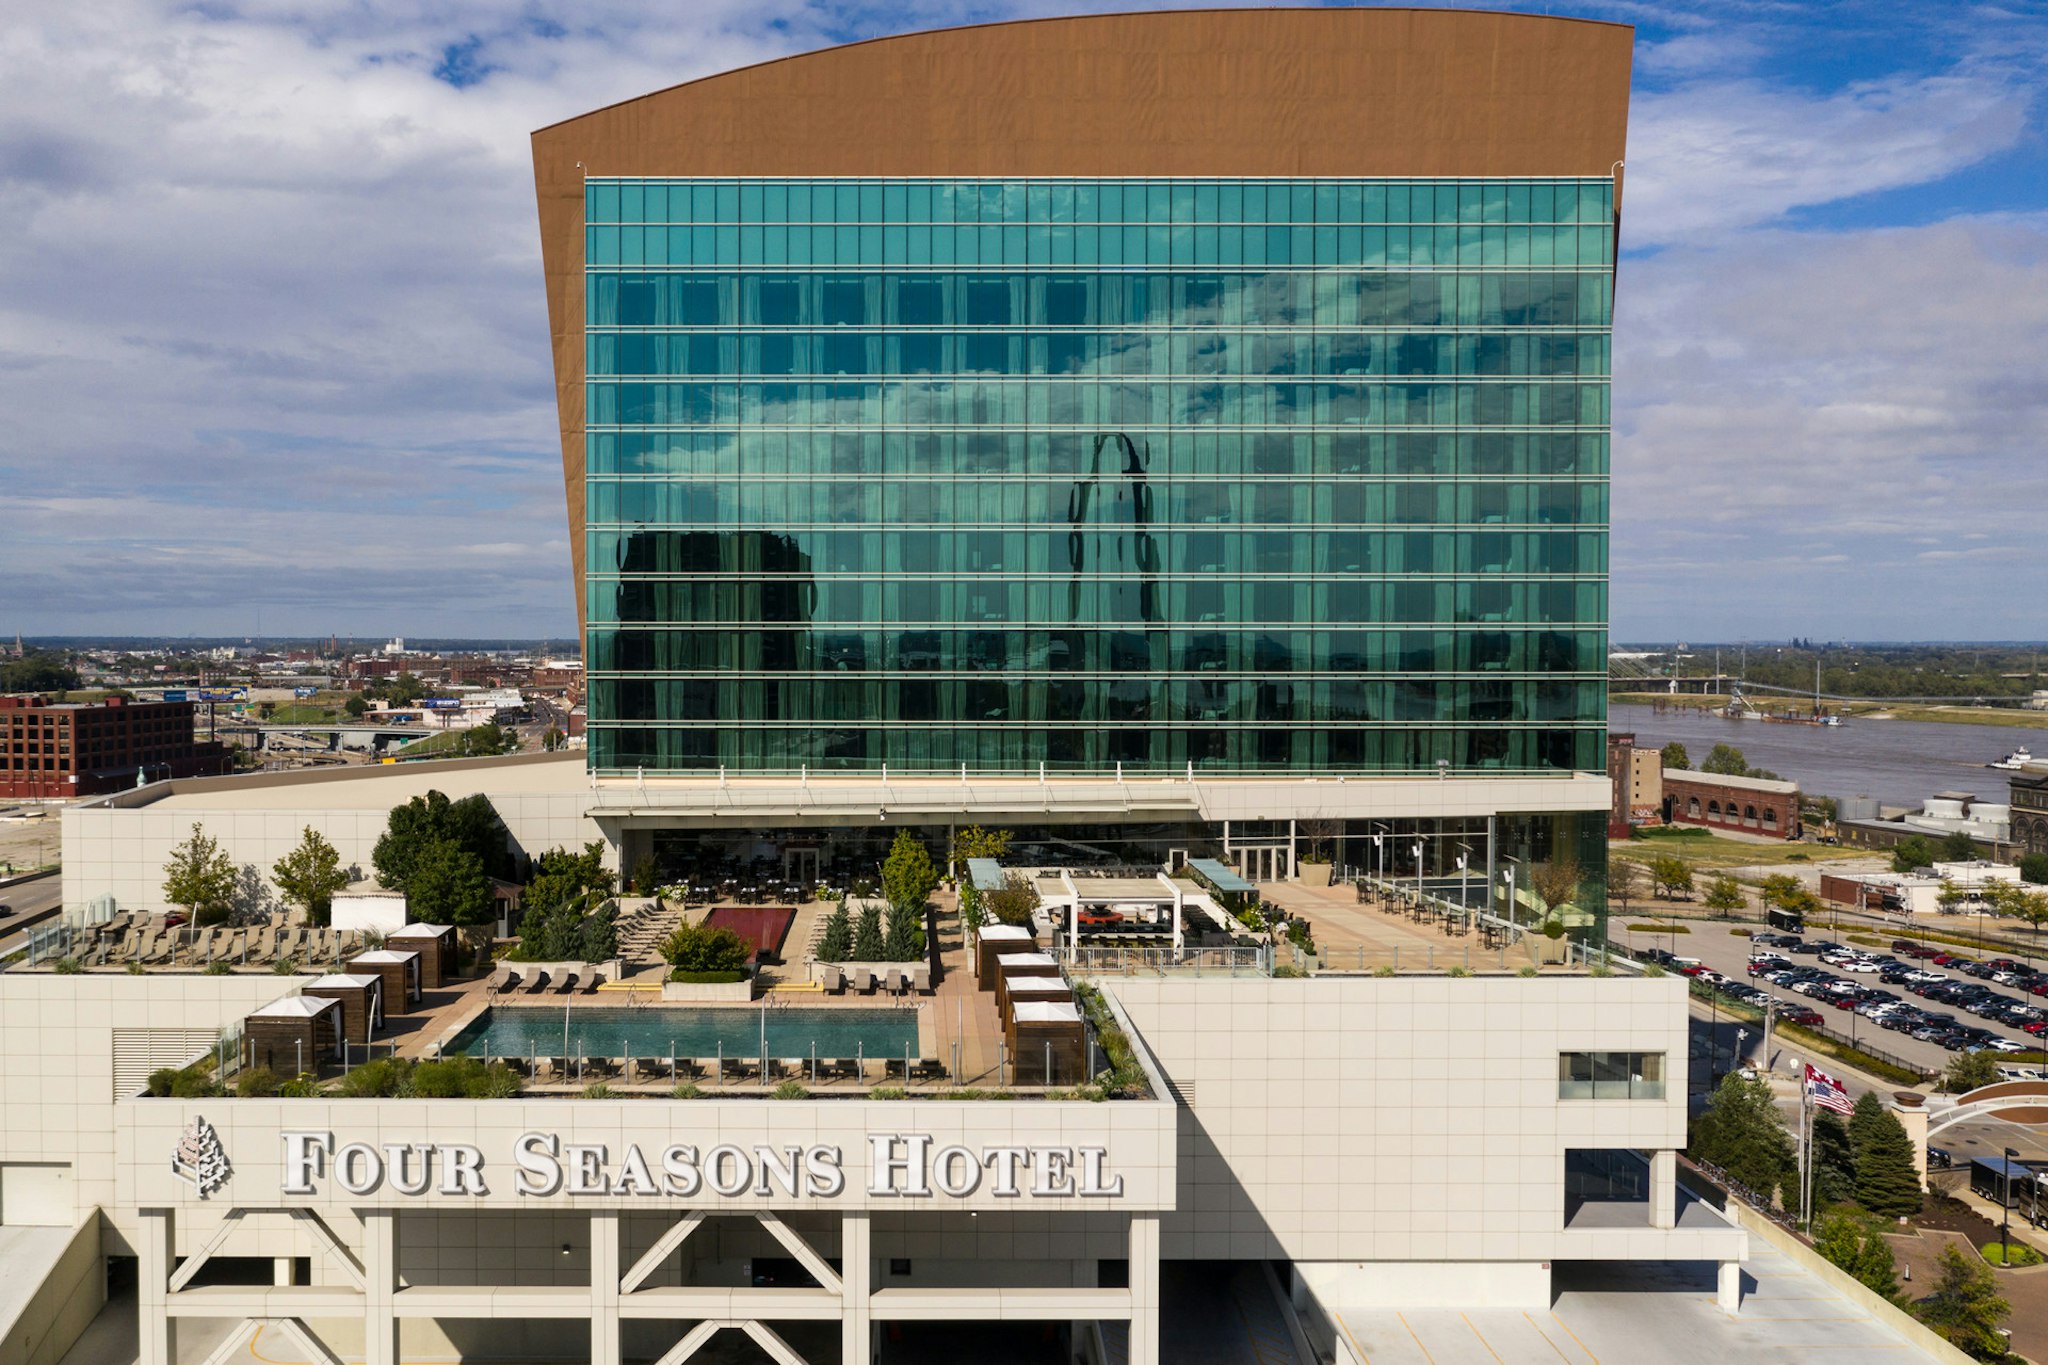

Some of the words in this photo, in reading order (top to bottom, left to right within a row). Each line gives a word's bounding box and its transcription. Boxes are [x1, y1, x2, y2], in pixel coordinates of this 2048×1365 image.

[280, 1131, 489, 1195] FOUR
[513, 1131, 844, 1197] SEASONS
[867, 1133, 1123, 1197] HOTEL
